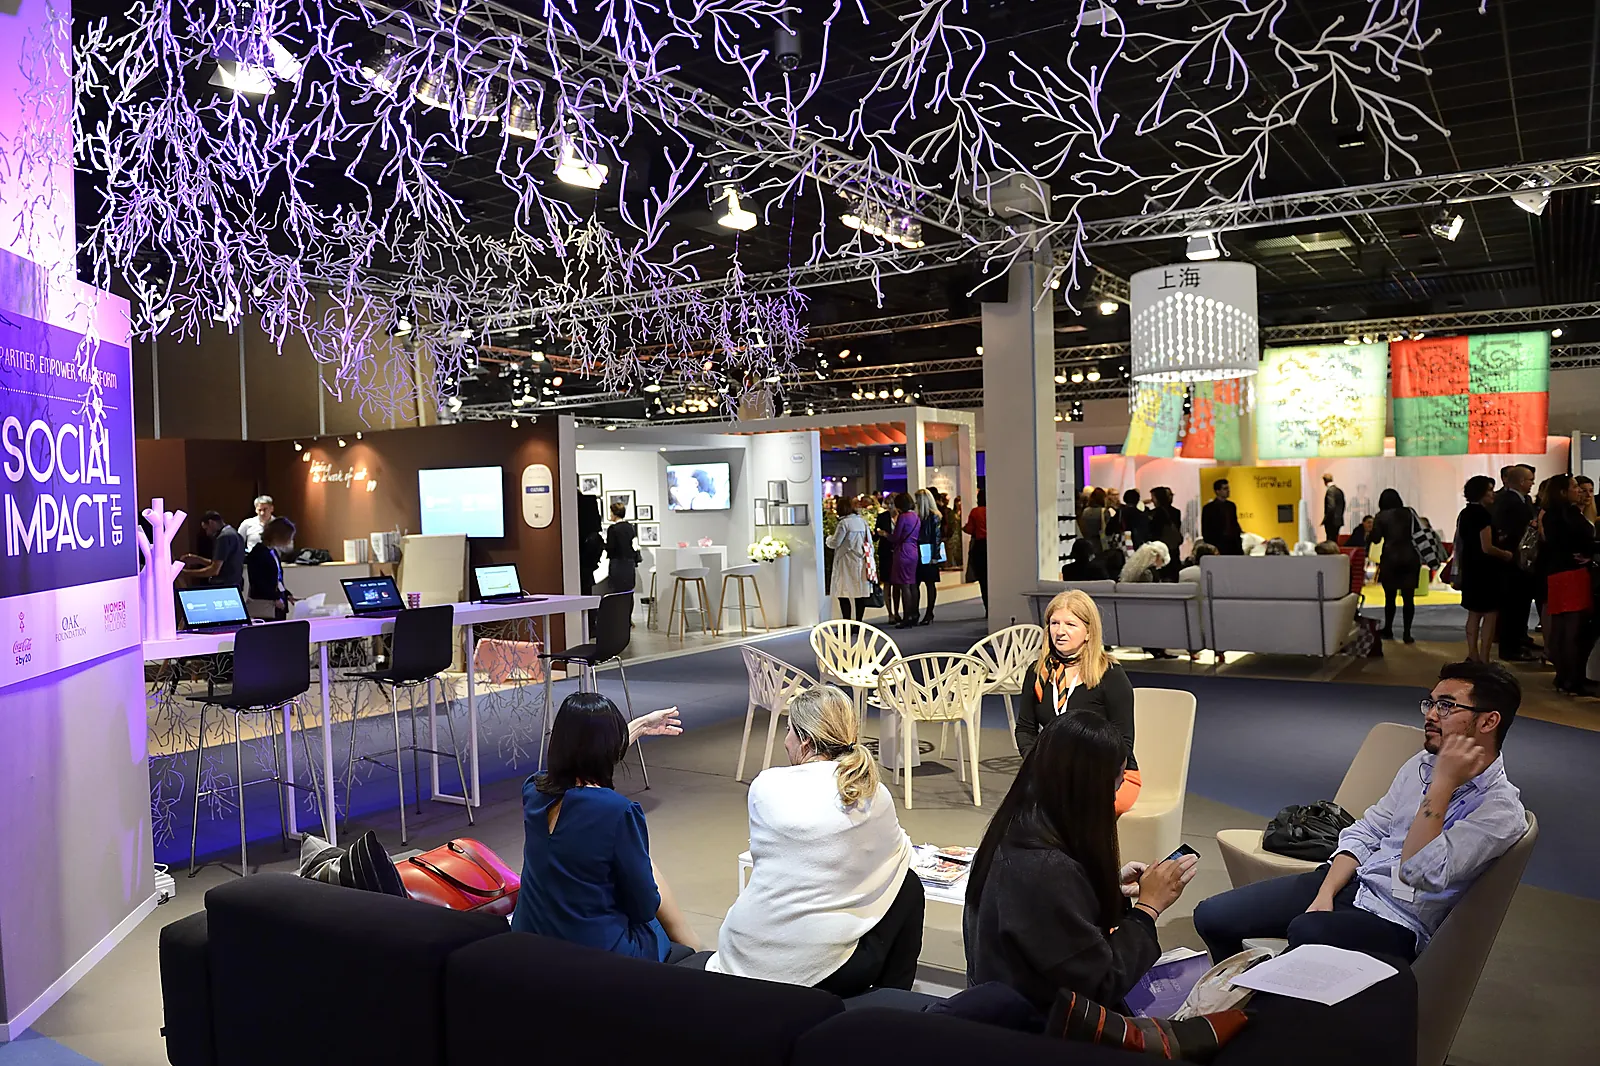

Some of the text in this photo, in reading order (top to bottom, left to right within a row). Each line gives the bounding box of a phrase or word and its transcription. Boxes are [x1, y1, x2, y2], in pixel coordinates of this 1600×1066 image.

[1158, 267, 1200, 290] 上海
[2, 415, 121, 485] SOCIAL
[4, 494, 108, 556] IMPACT
[110, 494, 123, 546] HUB
[103, 600, 126, 613] WOMEN
[61, 615, 79, 631] OAK
[55, 627, 87, 642] FOUNDATION
[15, 653, 32, 666] 5by20
